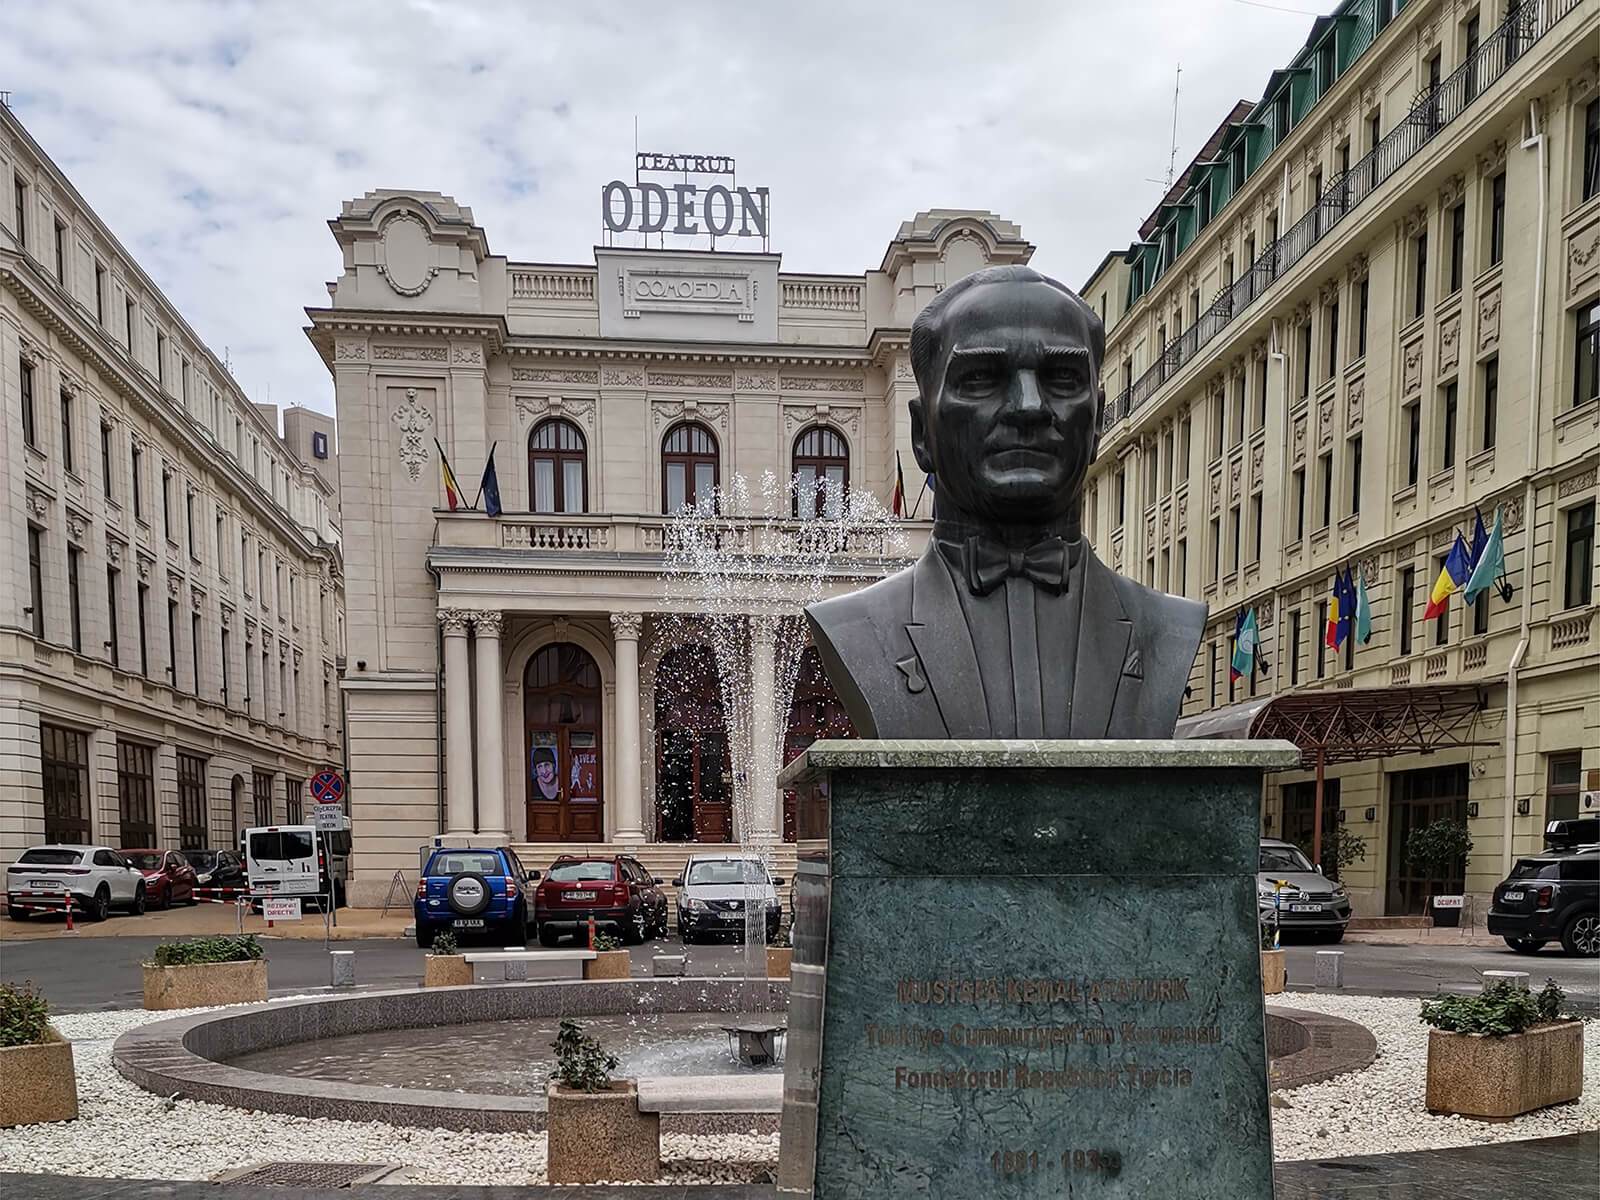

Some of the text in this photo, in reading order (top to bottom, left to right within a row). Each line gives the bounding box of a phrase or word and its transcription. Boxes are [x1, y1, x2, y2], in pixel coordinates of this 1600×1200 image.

[637, 152, 734, 173] TEATRUL
[603, 180, 769, 237] ODEON
[636, 280, 742, 300] COMOEDIA
[897, 977, 1000, 1004] MUSTAFA
[1006, 976, 1081, 1002] KEMAL
[895, 1065, 1008, 1089] Fondatorul
[991, 1150, 1114, 1172] 1881 193
